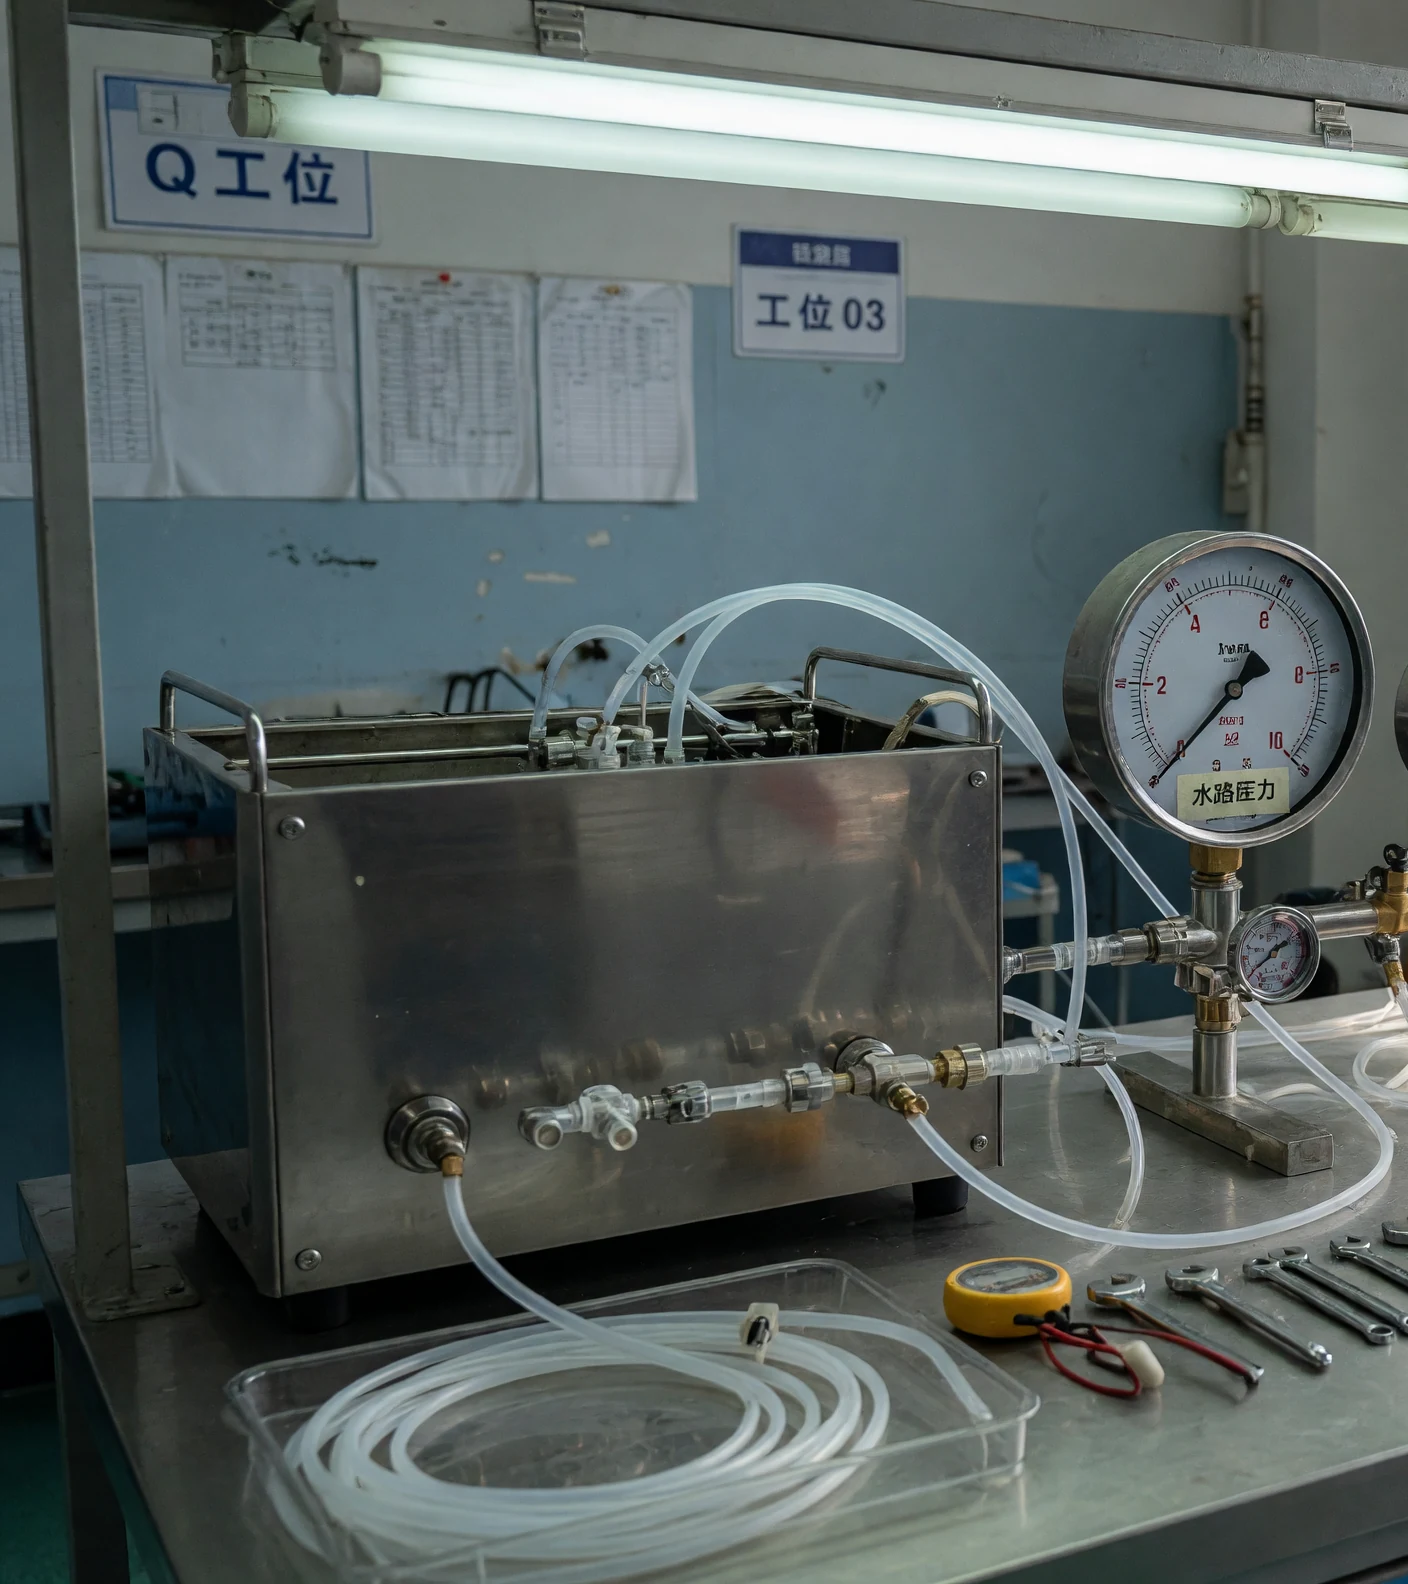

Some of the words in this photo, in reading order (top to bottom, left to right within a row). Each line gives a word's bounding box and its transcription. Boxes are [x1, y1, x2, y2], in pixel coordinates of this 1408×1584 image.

[145, 142, 197, 198] Q
[214, 148, 338, 205] 工位
[756, 293, 833, 332] 工位
[843, 298, 886, 332] 03
[1156, 675, 1167, 695] 2
[1268, 731, 1283, 750] 10
